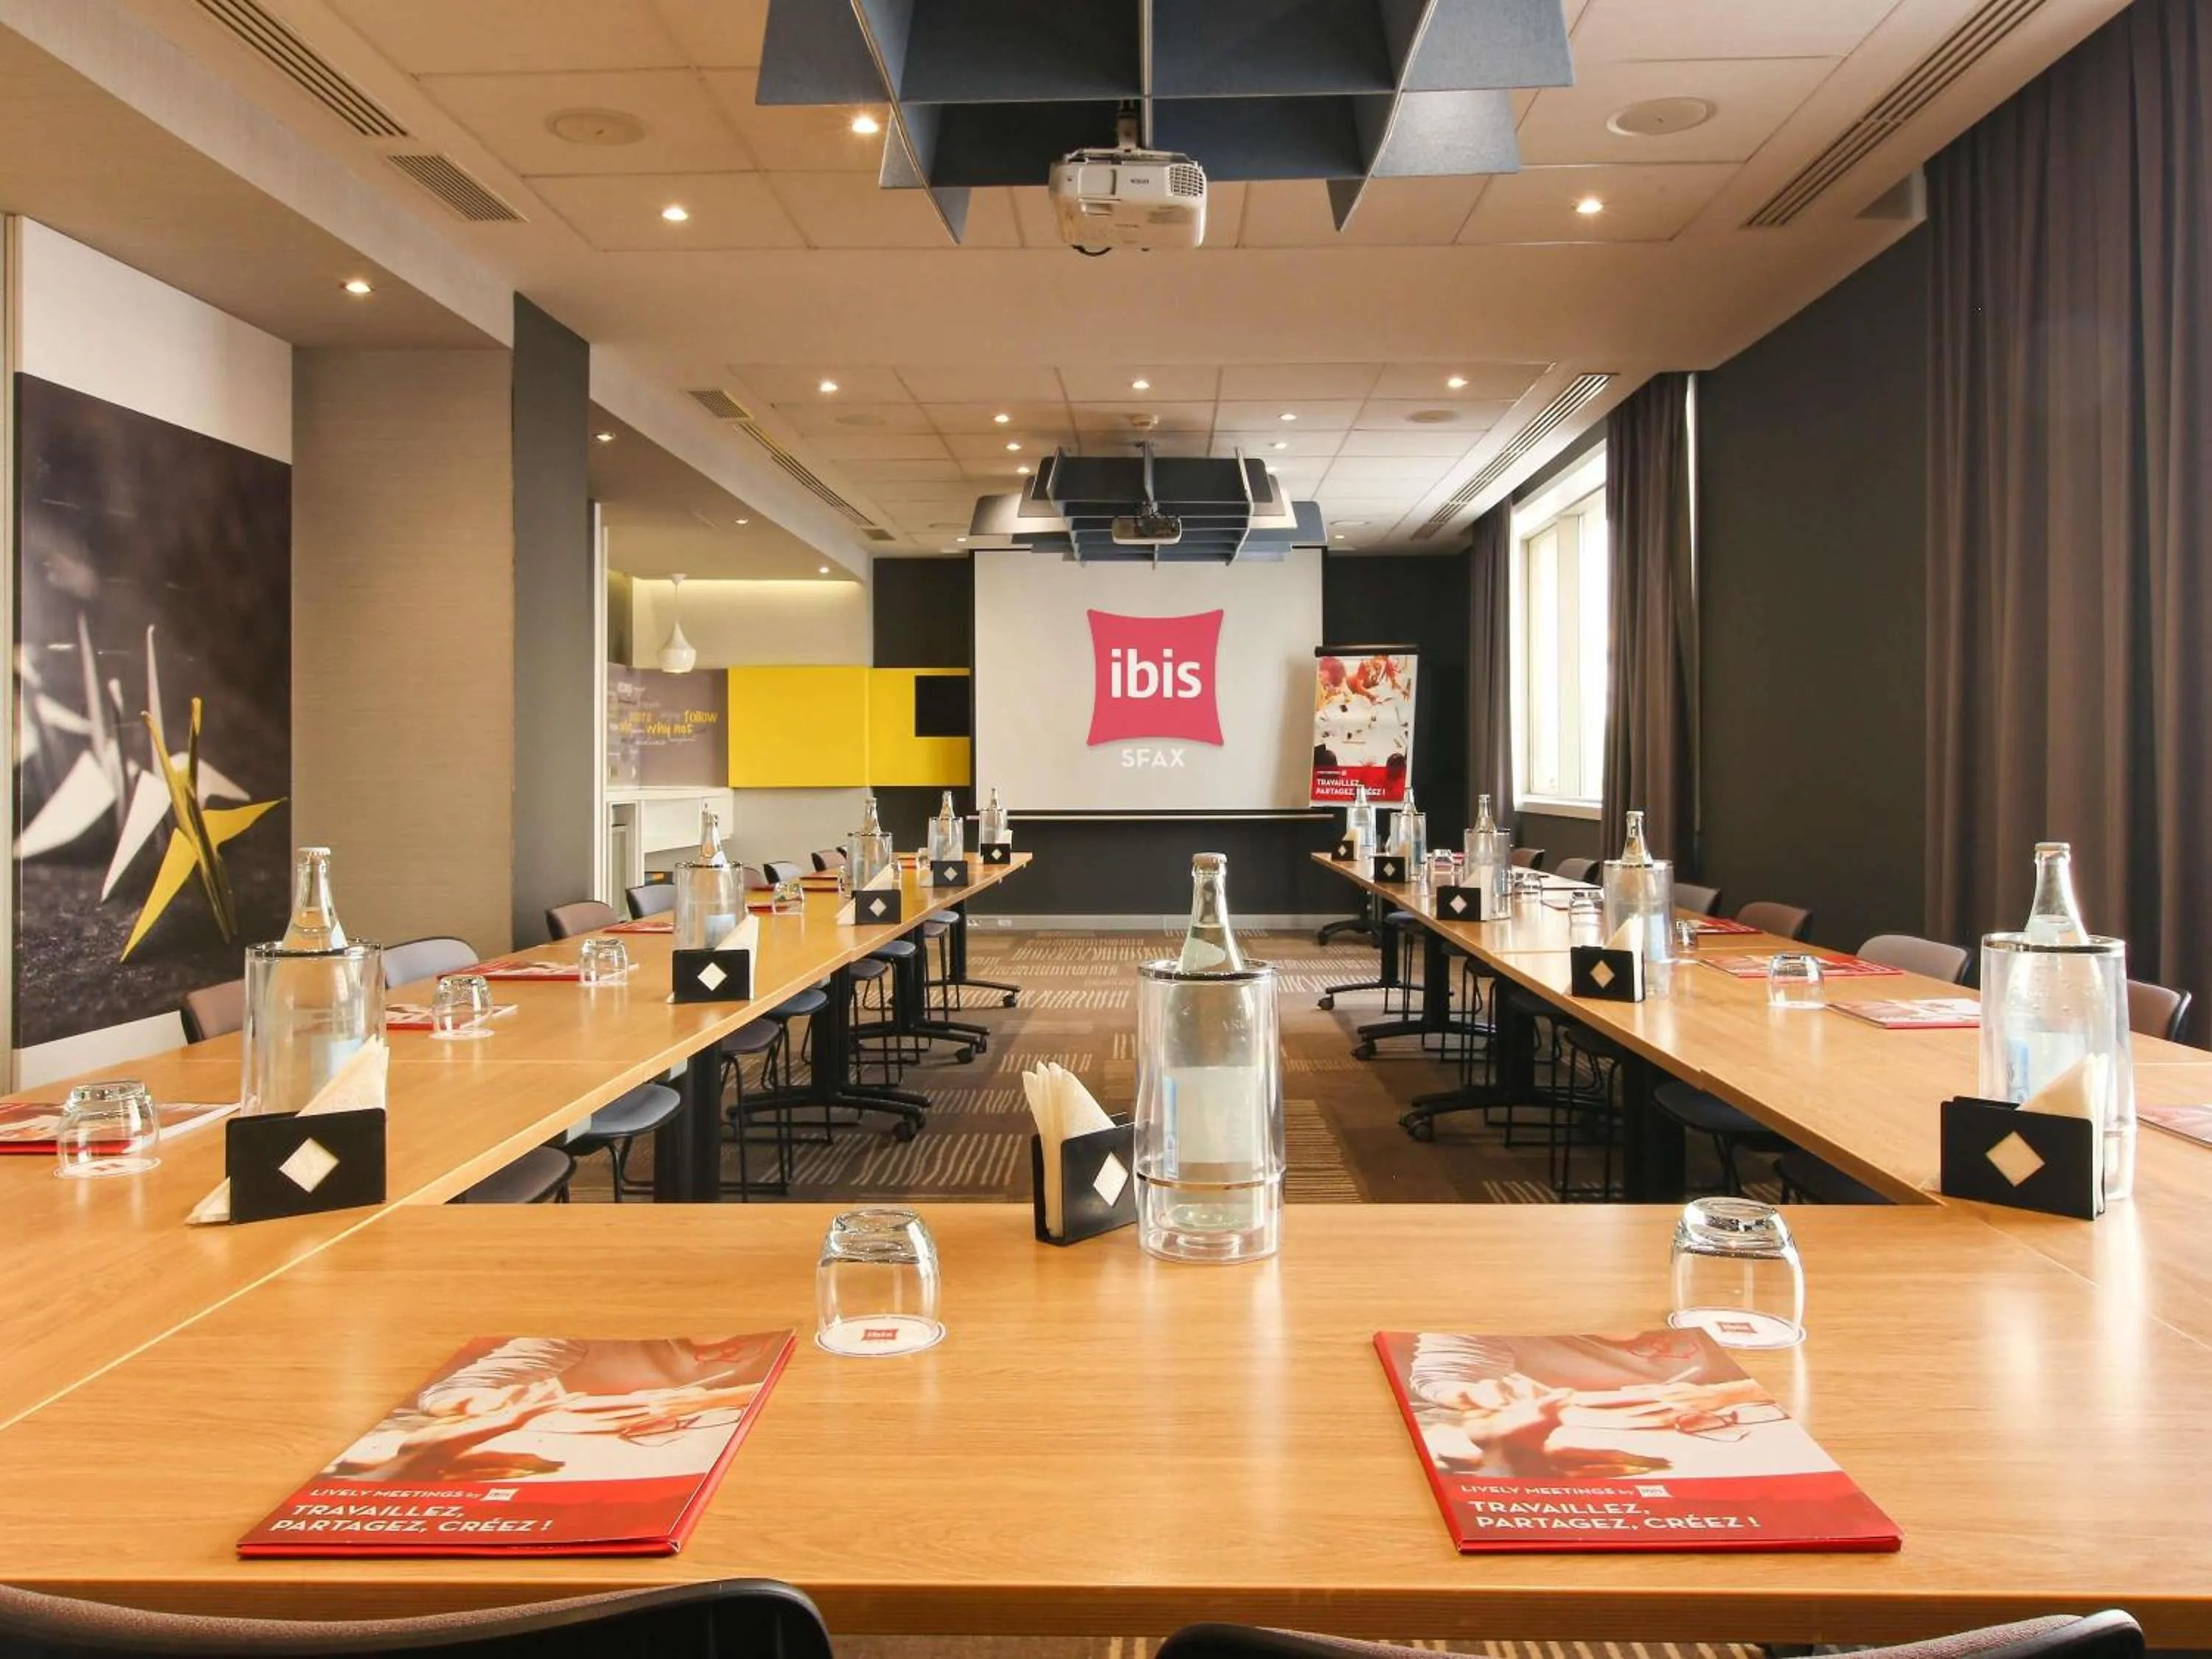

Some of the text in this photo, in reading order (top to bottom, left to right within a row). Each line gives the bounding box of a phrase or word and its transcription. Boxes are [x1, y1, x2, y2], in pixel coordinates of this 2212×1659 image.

[1111, 648, 1202, 698] ibis
[1121, 748, 1185, 768] SFAX
[310, 1489, 372, 1497] LIVELY
[372, 1489, 464, 1498] MEETINGS
[1461, 1486, 1520, 1494] LIVELY
[1524, 1486, 1615, 1495] MEETINGS
[292, 1504, 465, 1517] TRAVAILLEZ,
[1467, 1500, 1650, 1514] TRAVAILLEZ,
[269, 1519, 428, 1533] PARTAGEZ,
[438, 1517, 538, 1532] CRÉEZ
[1475, 1516, 1639, 1530] PARTAGEZ,
[1644, 1514, 1745, 1528] CRÉEZ
